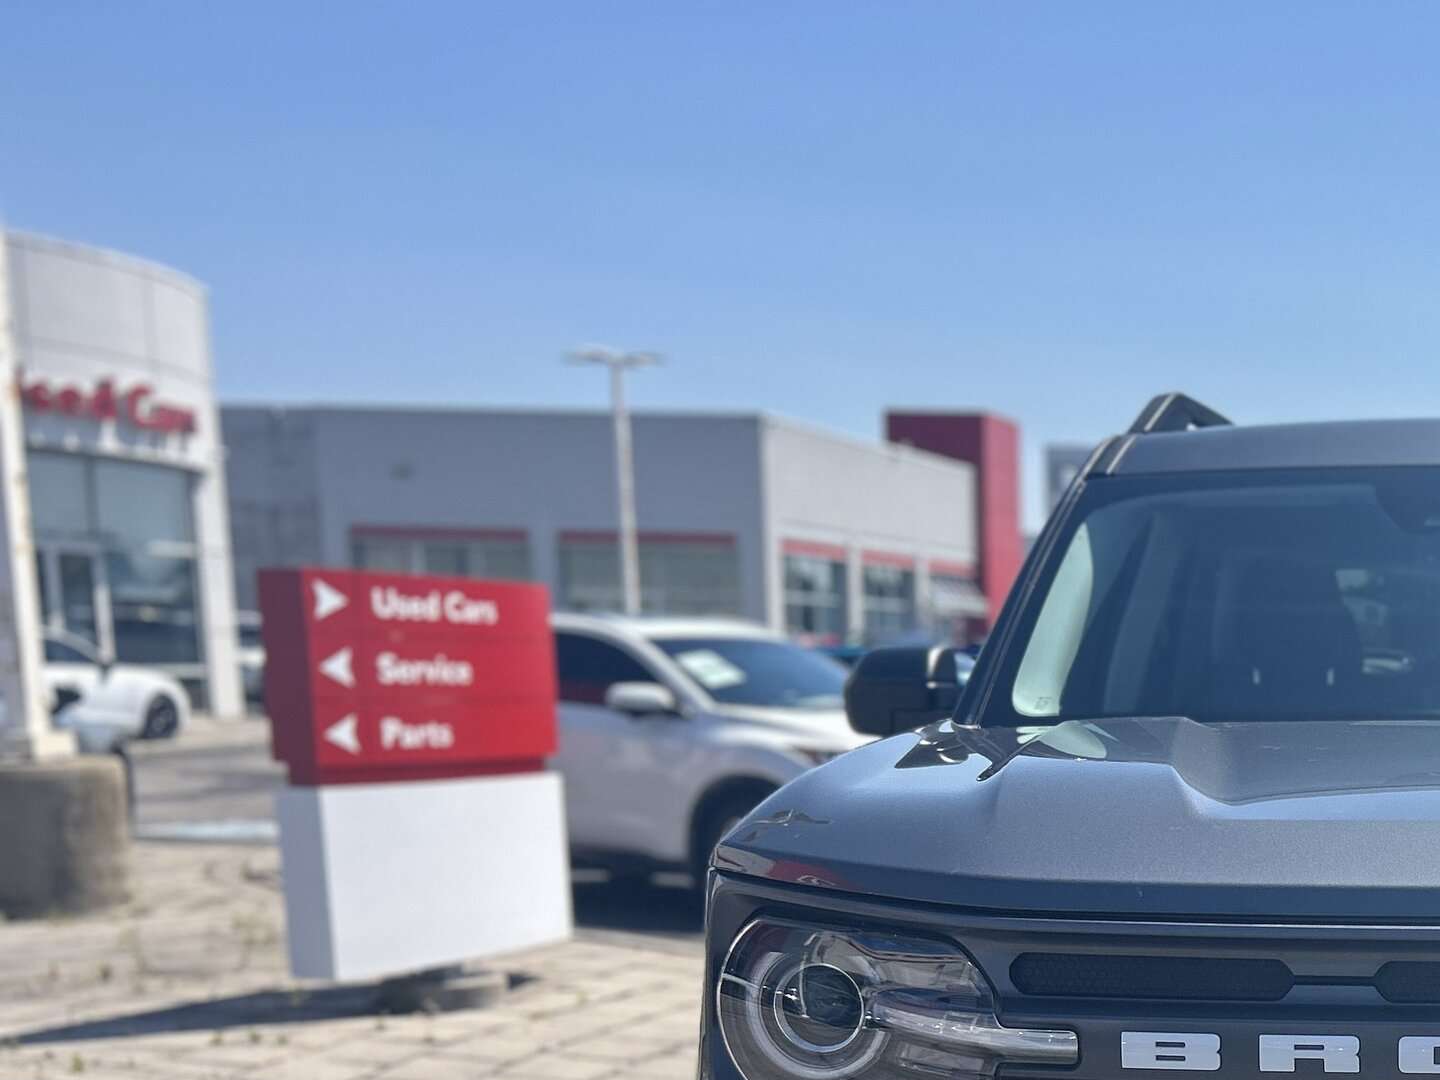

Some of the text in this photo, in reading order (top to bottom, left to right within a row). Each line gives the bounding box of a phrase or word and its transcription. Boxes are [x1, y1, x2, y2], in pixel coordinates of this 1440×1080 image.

[17, 367, 118, 421] sed
[371, 586, 498, 625] Used Cars
[375, 651, 474, 687] Service
[379, 715, 455, 749] Parts
